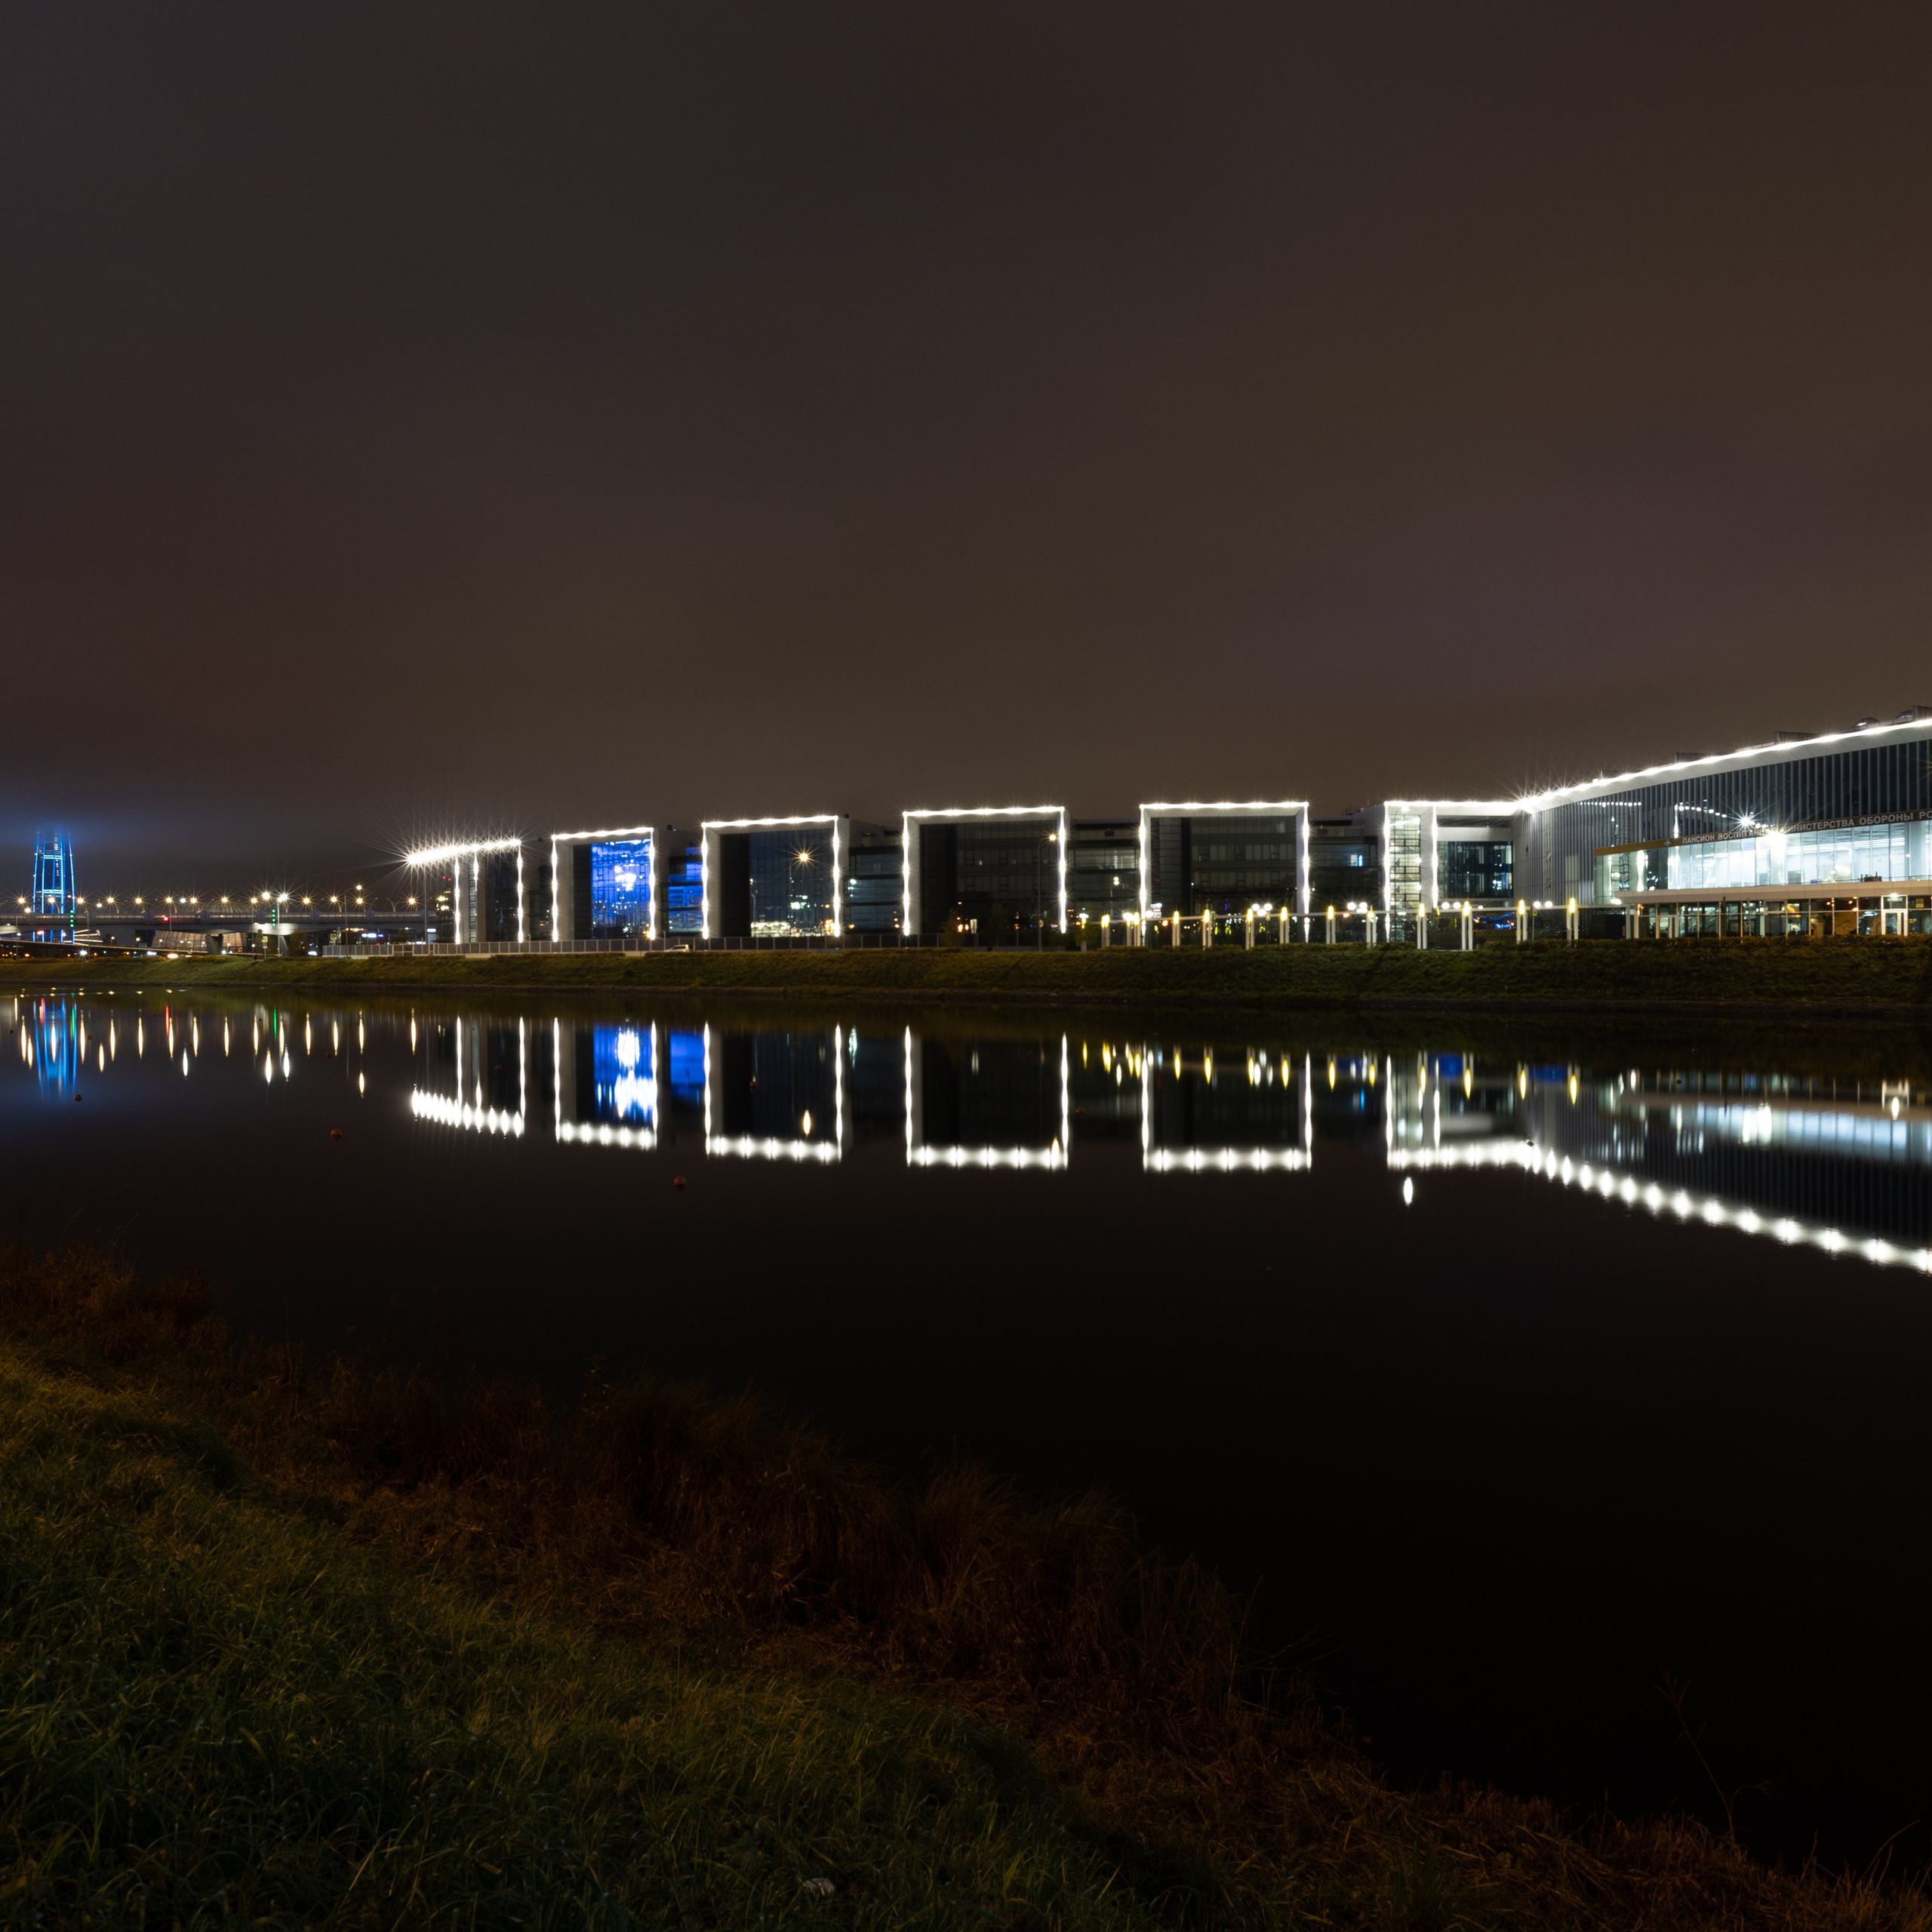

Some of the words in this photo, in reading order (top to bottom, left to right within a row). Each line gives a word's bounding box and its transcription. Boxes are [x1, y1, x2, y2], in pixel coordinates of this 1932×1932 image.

[1682, 834, 1715, 844] ПАНСИОН
[1718, 827, 1775, 840] ВОСПИТАН
[1859, 812, 1914, 825] ОБОРОНЫ
